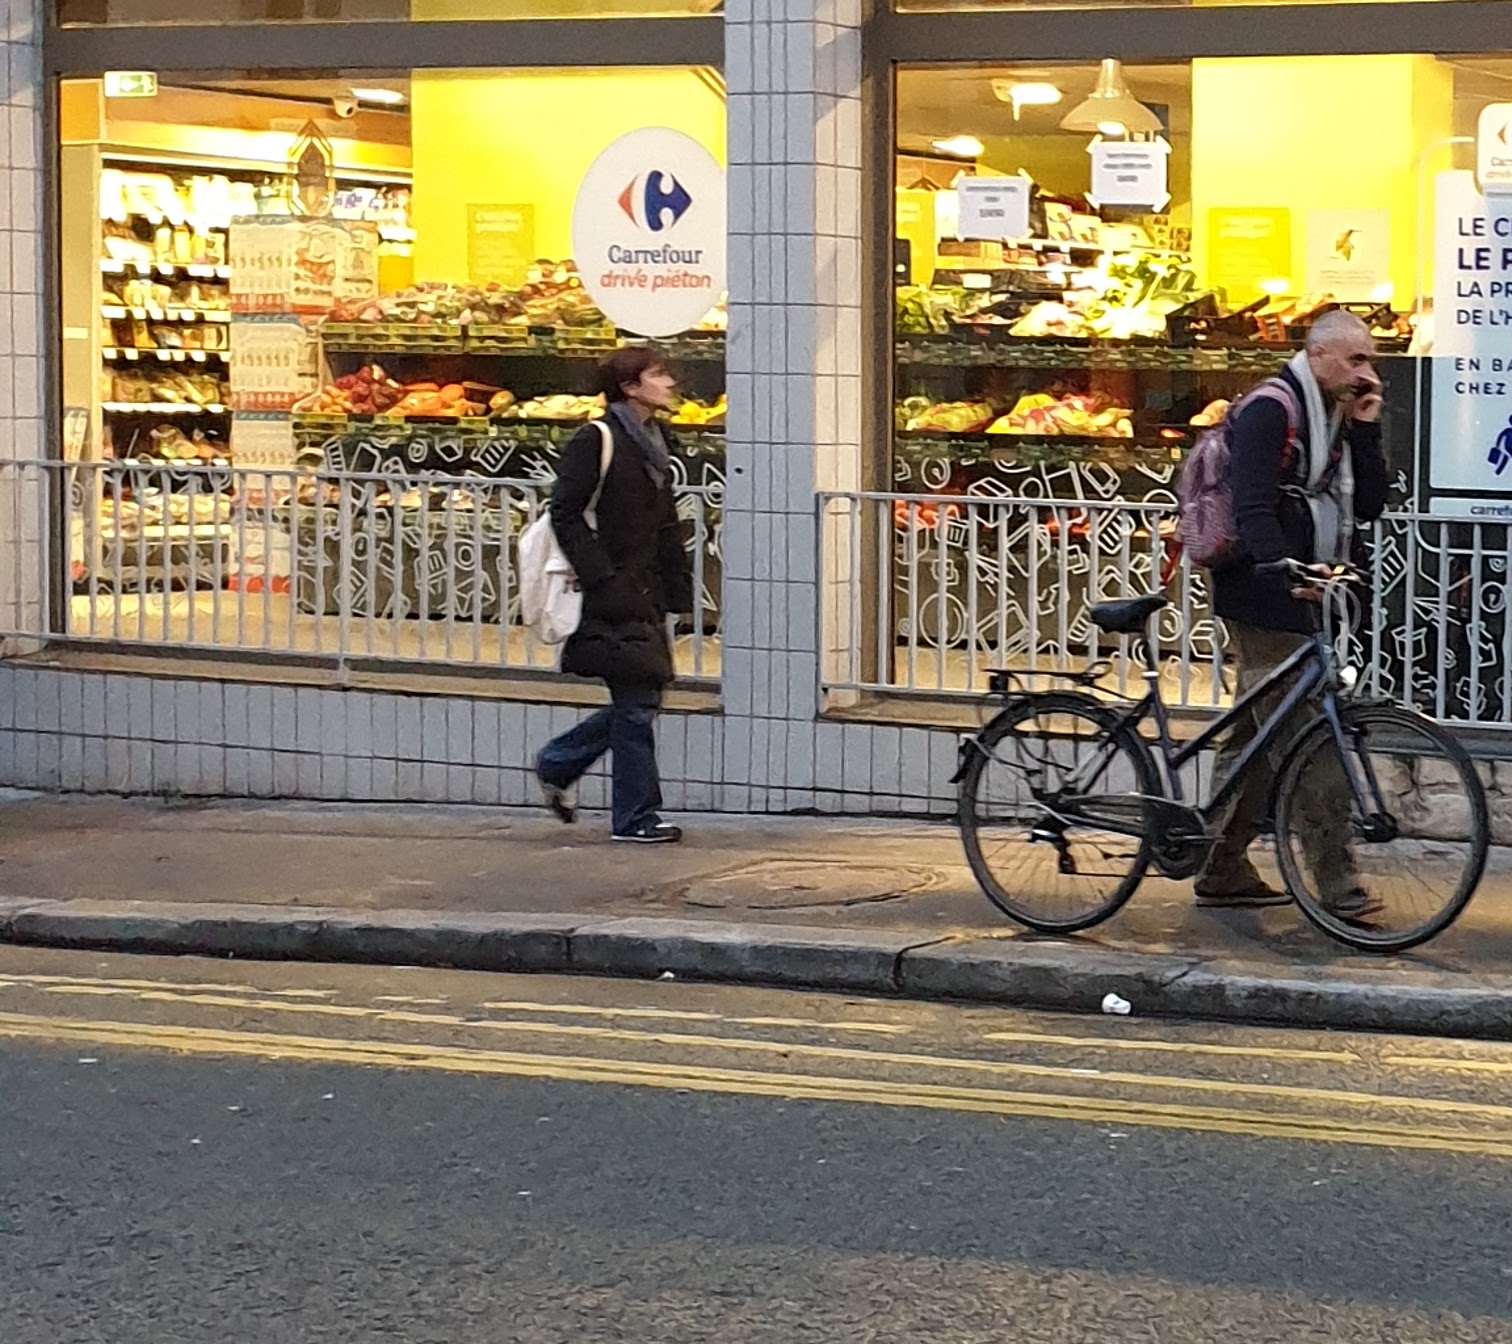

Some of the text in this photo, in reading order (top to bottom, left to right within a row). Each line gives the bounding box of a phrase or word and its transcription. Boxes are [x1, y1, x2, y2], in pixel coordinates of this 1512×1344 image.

[1458, 217, 1486, 237] LE
[607, 243, 704, 265] Carrefour
[1458, 247, 1491, 271] LE
[600, 268, 712, 293] drive piéton
[1456, 280, 1484, 298] LA
[1456, 309, 1483, 325] DE
[1455, 357, 1481, 372] EN
[1454, 381, 1507, 396] CHEZ
